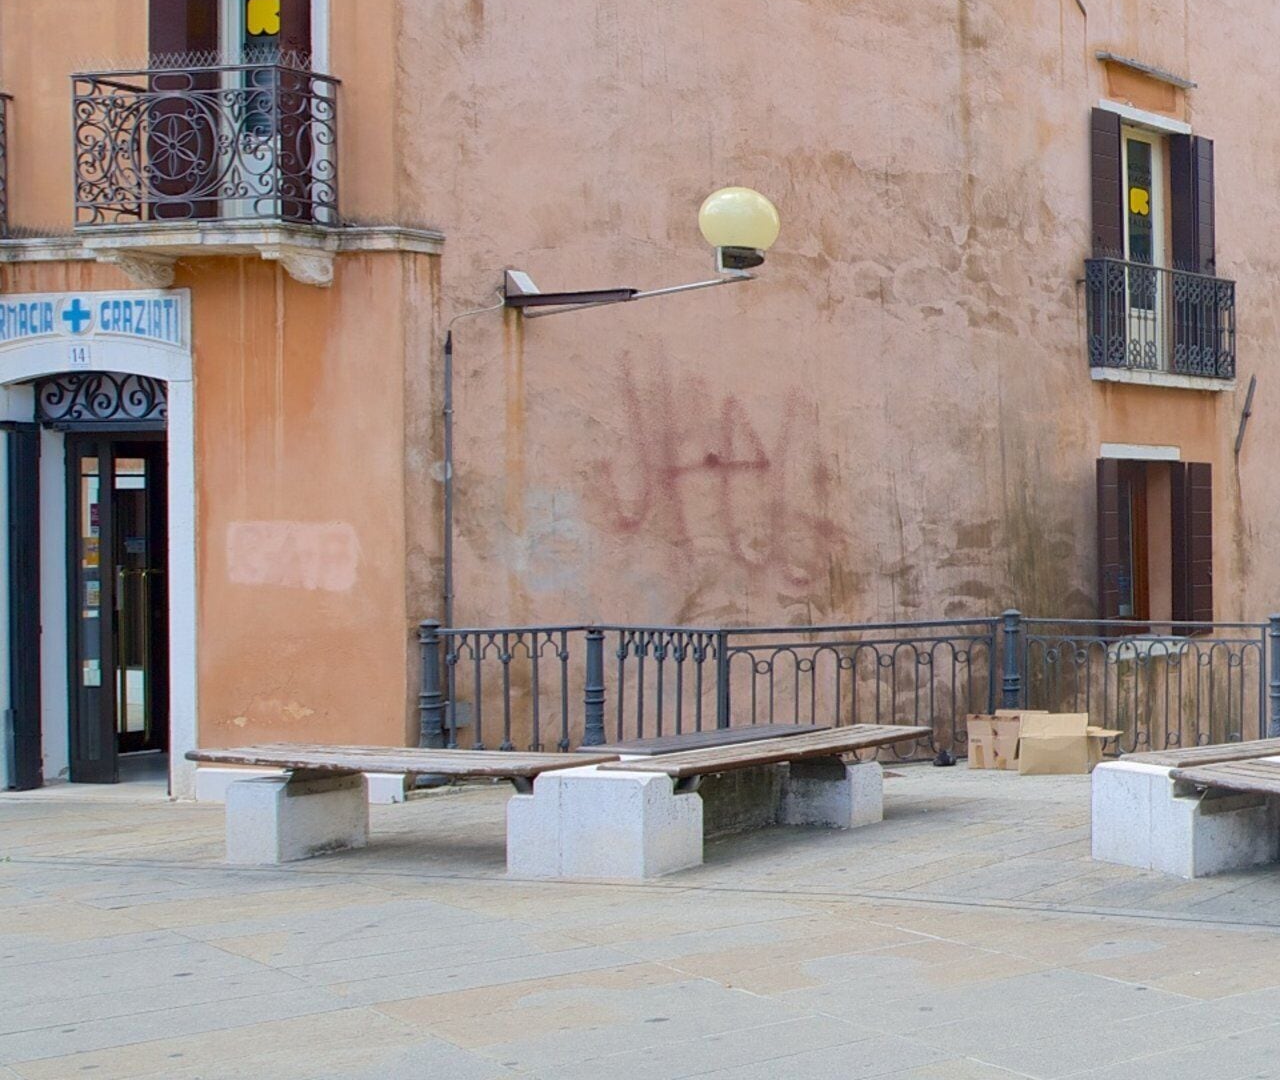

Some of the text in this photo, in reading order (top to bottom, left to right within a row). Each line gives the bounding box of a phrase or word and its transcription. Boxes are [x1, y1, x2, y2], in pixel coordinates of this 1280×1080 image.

[0, 299, 179, 344] RMACIA GRAZIATI
[72, 347, 86, 363] 14
